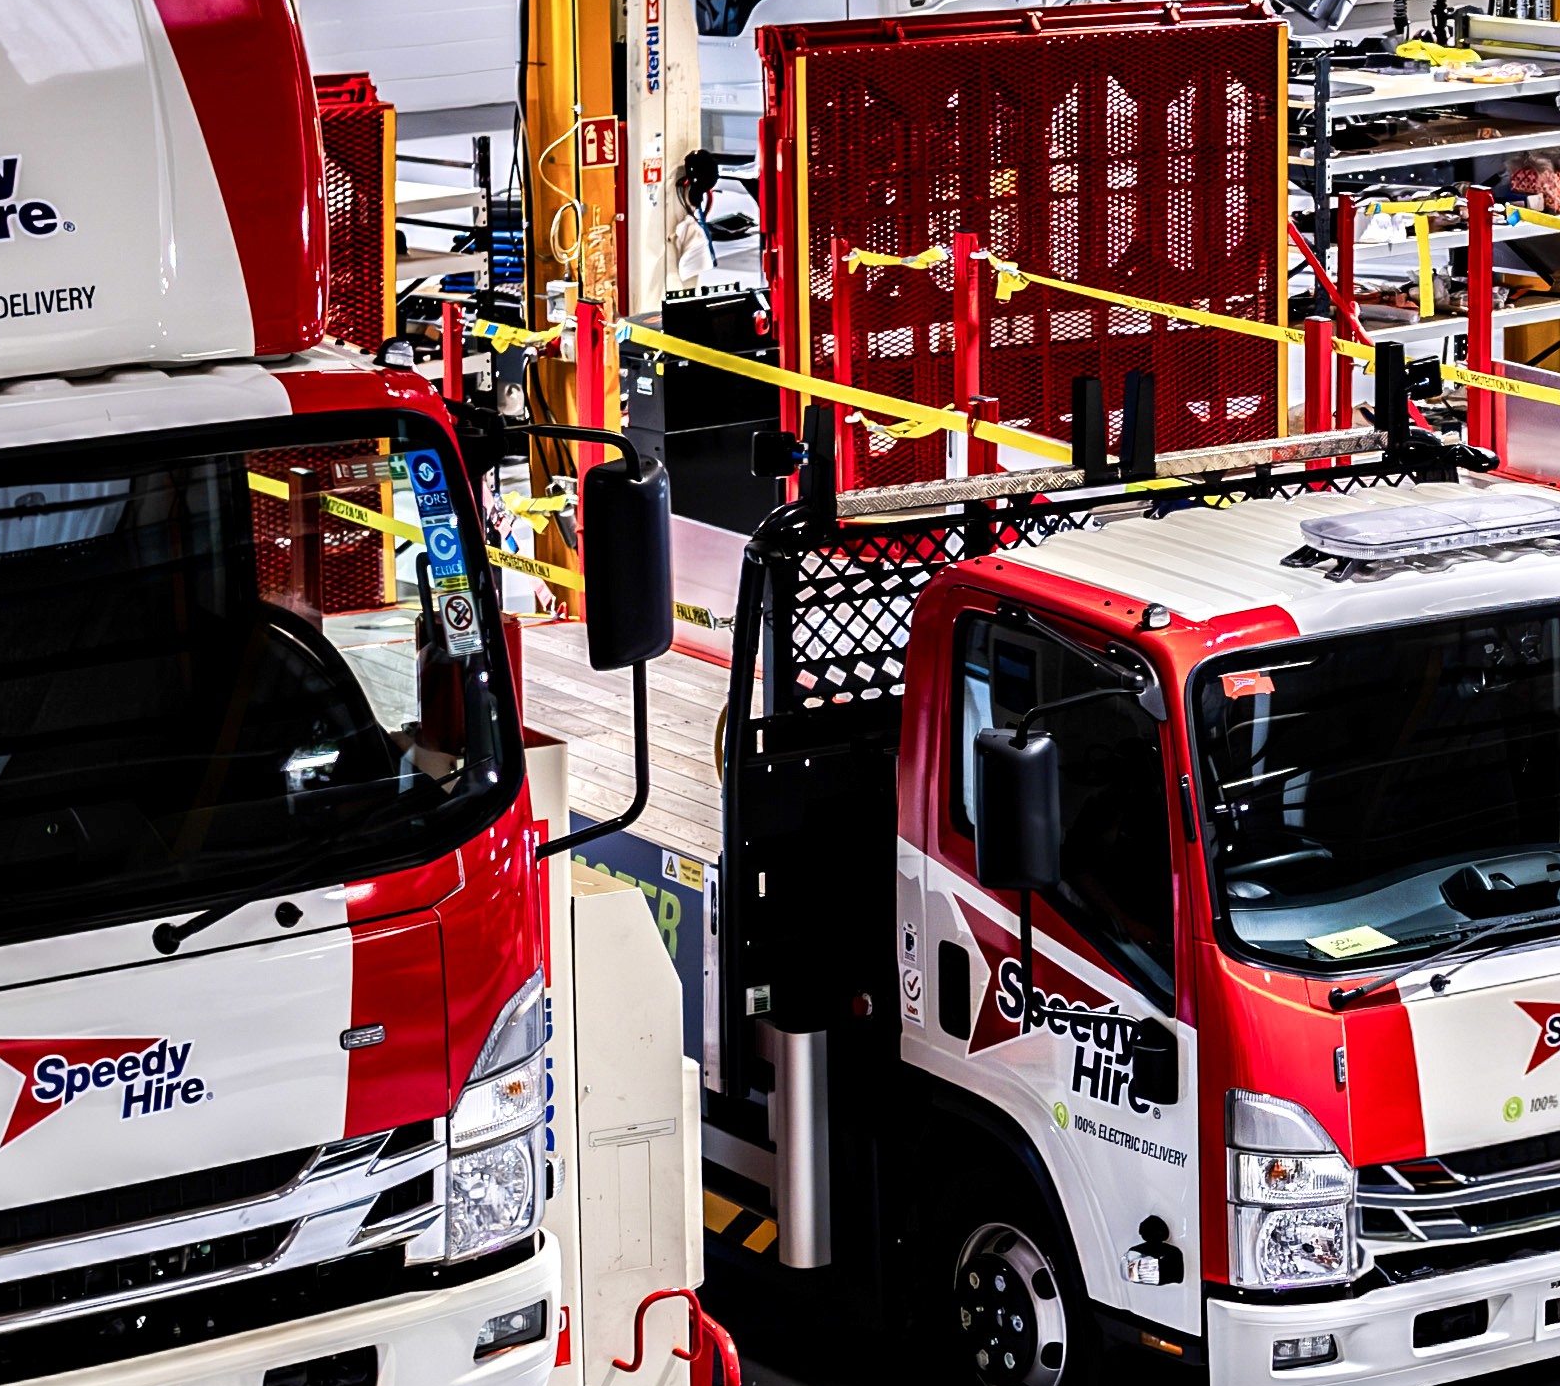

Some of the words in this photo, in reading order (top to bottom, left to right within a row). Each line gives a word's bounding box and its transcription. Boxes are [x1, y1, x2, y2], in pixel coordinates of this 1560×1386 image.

[1456, 369, 1470, 382] FALL
[1471, 372, 1504, 392] PROTECTION
[1504, 379, 1521, 394] ONLY
[417, 492, 449, 508] FORS
[996, 961, 1142, 1065] Speedy
[34, 1038, 192, 1105] Speedy
[121, 1076, 205, 1119] Hire
[1529, 1091, 1558, 1113] 100%
[1074, 1114, 1096, 1137] 100%
[1098, 1123, 1140, 1154] ELECTRIC
[1141, 1137, 1188, 1169] DELIVERY
